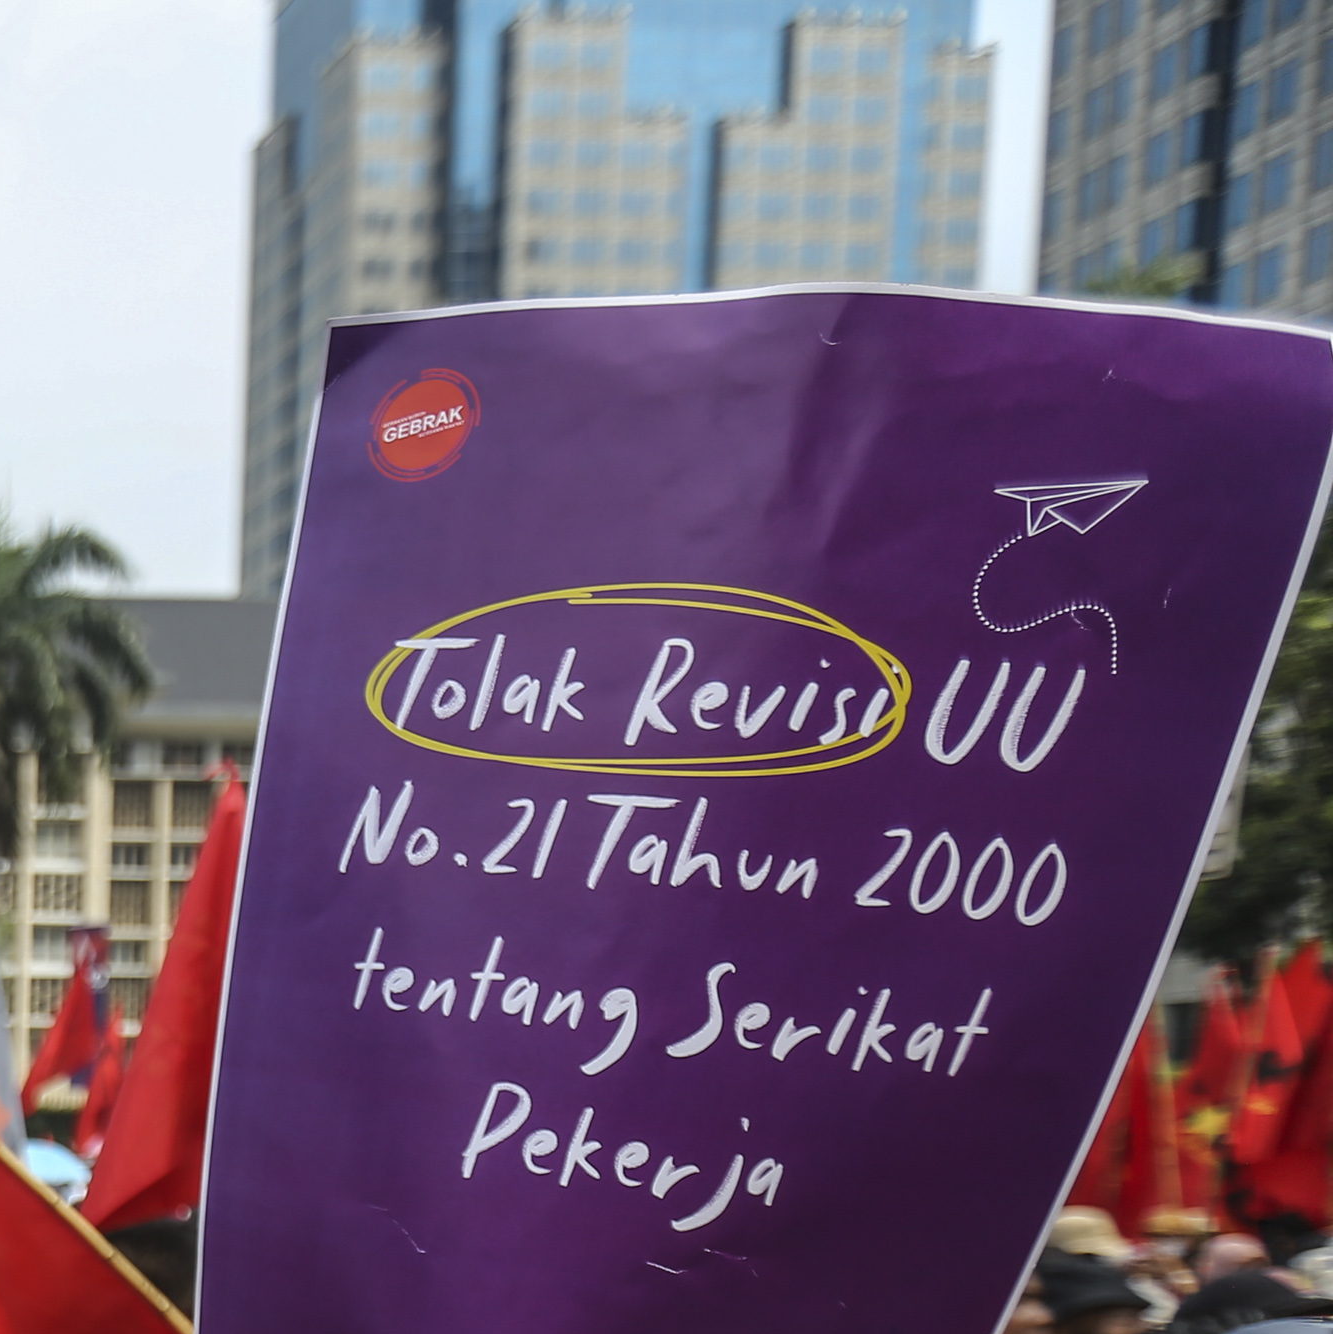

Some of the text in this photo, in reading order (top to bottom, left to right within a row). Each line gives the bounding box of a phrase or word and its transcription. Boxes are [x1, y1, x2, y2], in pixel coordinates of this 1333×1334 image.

[383, 405, 464, 443] GEBRAK
[395, 634, 1086, 772] Tolak Revisi UU
[586, 795, 819, 899] Tahun
[854, 829, 1068, 926] 2000
[354, 927, 990, 1077] tentang Serikat
[461, 1081, 785, 1233] Pekerja
